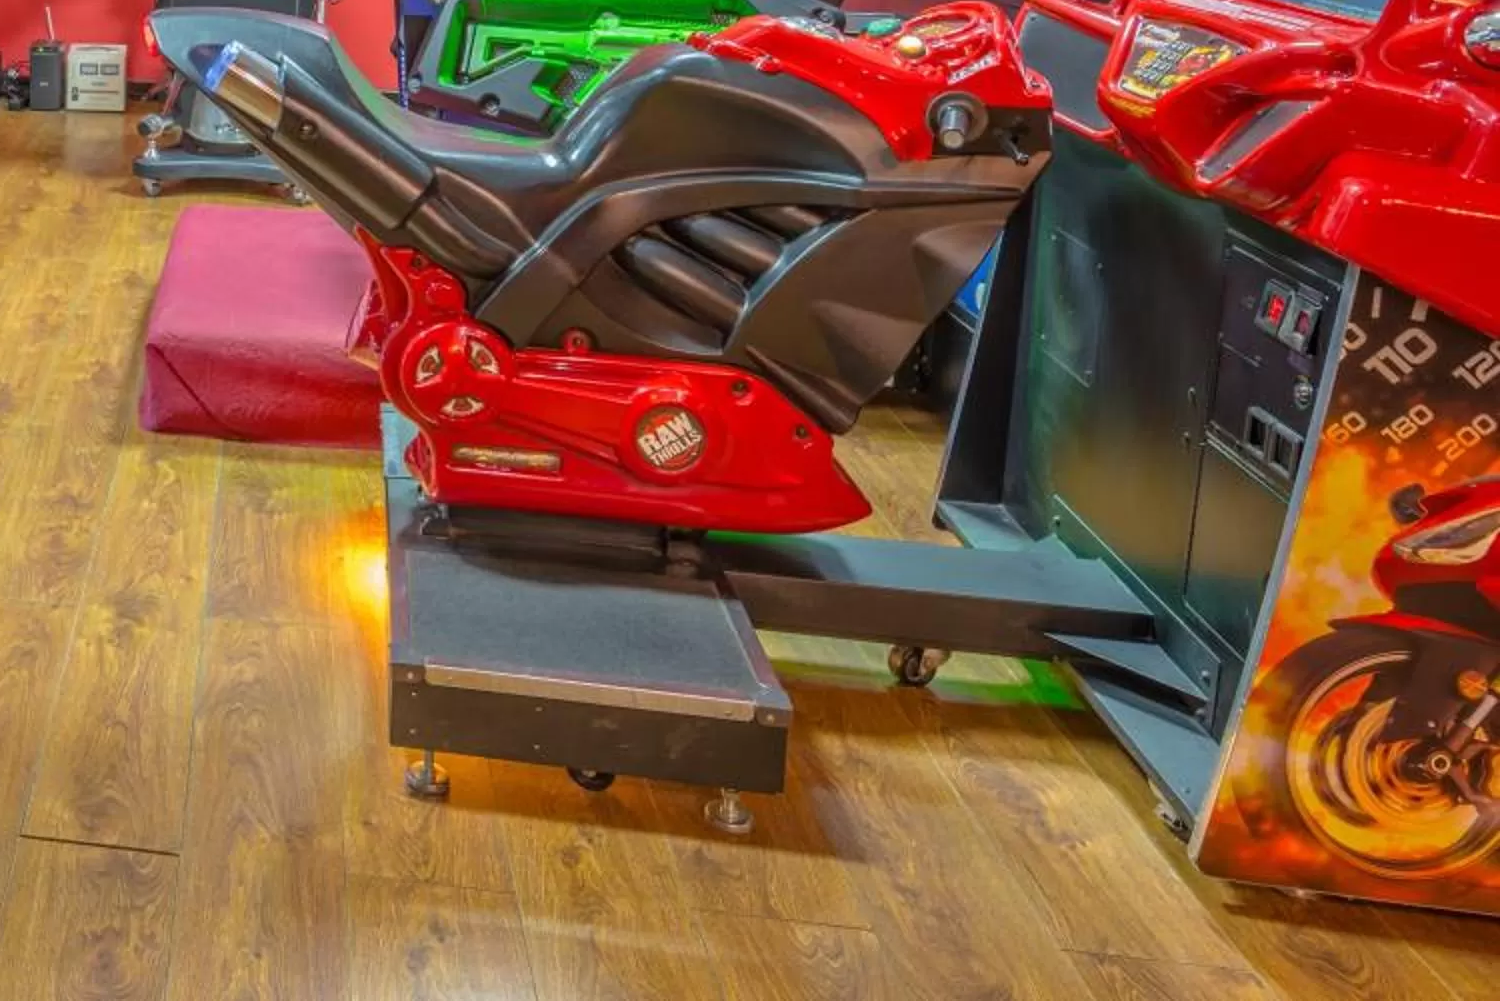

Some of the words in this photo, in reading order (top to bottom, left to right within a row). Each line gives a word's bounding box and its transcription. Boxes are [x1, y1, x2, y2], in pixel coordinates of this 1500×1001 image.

[1363, 327, 1438, 385] 110
[1451, 339, 1500, 390] 12
[638, 411, 694, 456] RAW
[1320, 410, 1368, 444] 60
[1380, 403, 1435, 444] 180
[1436, 413, 1498, 462] 200
